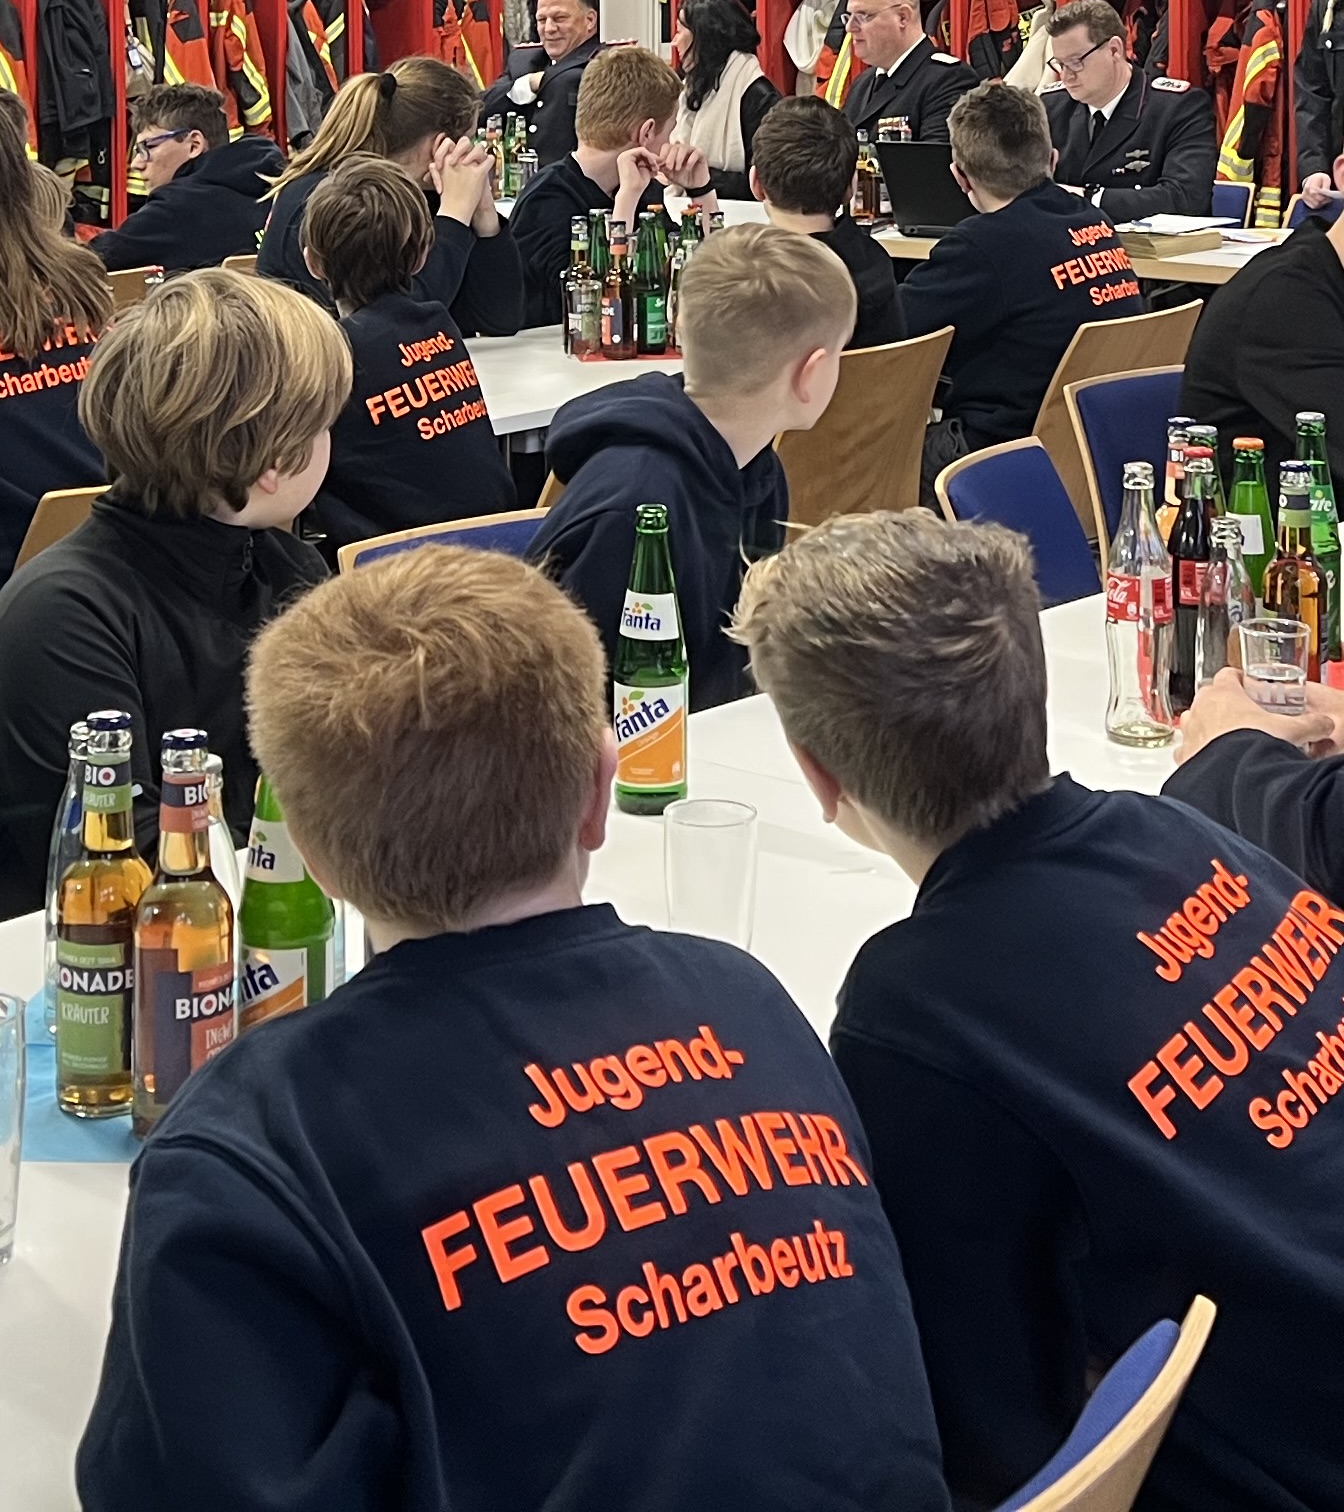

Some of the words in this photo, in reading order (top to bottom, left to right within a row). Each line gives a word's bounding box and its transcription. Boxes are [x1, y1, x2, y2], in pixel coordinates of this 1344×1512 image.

[398, 331, 455, 368] Jugend-
[366, 359, 478, 425] FEUERWE
[417, 397, 488, 440] Scharbeu
[1171, 450, 1184, 462] BI
[622, 607, 661, 632] Fanta
[615, 698, 670, 743] Fanta
[247, 845, 276, 871] nta
[1136, 858, 1251, 982] Jugend-
[57, 968, 134, 992] ONADE
[524, 1025, 744, 1128] Jugend-
[421, 1112, 868, 1312] FEUERWEHR
[566, 1219, 853, 1355] Scharbeutz
